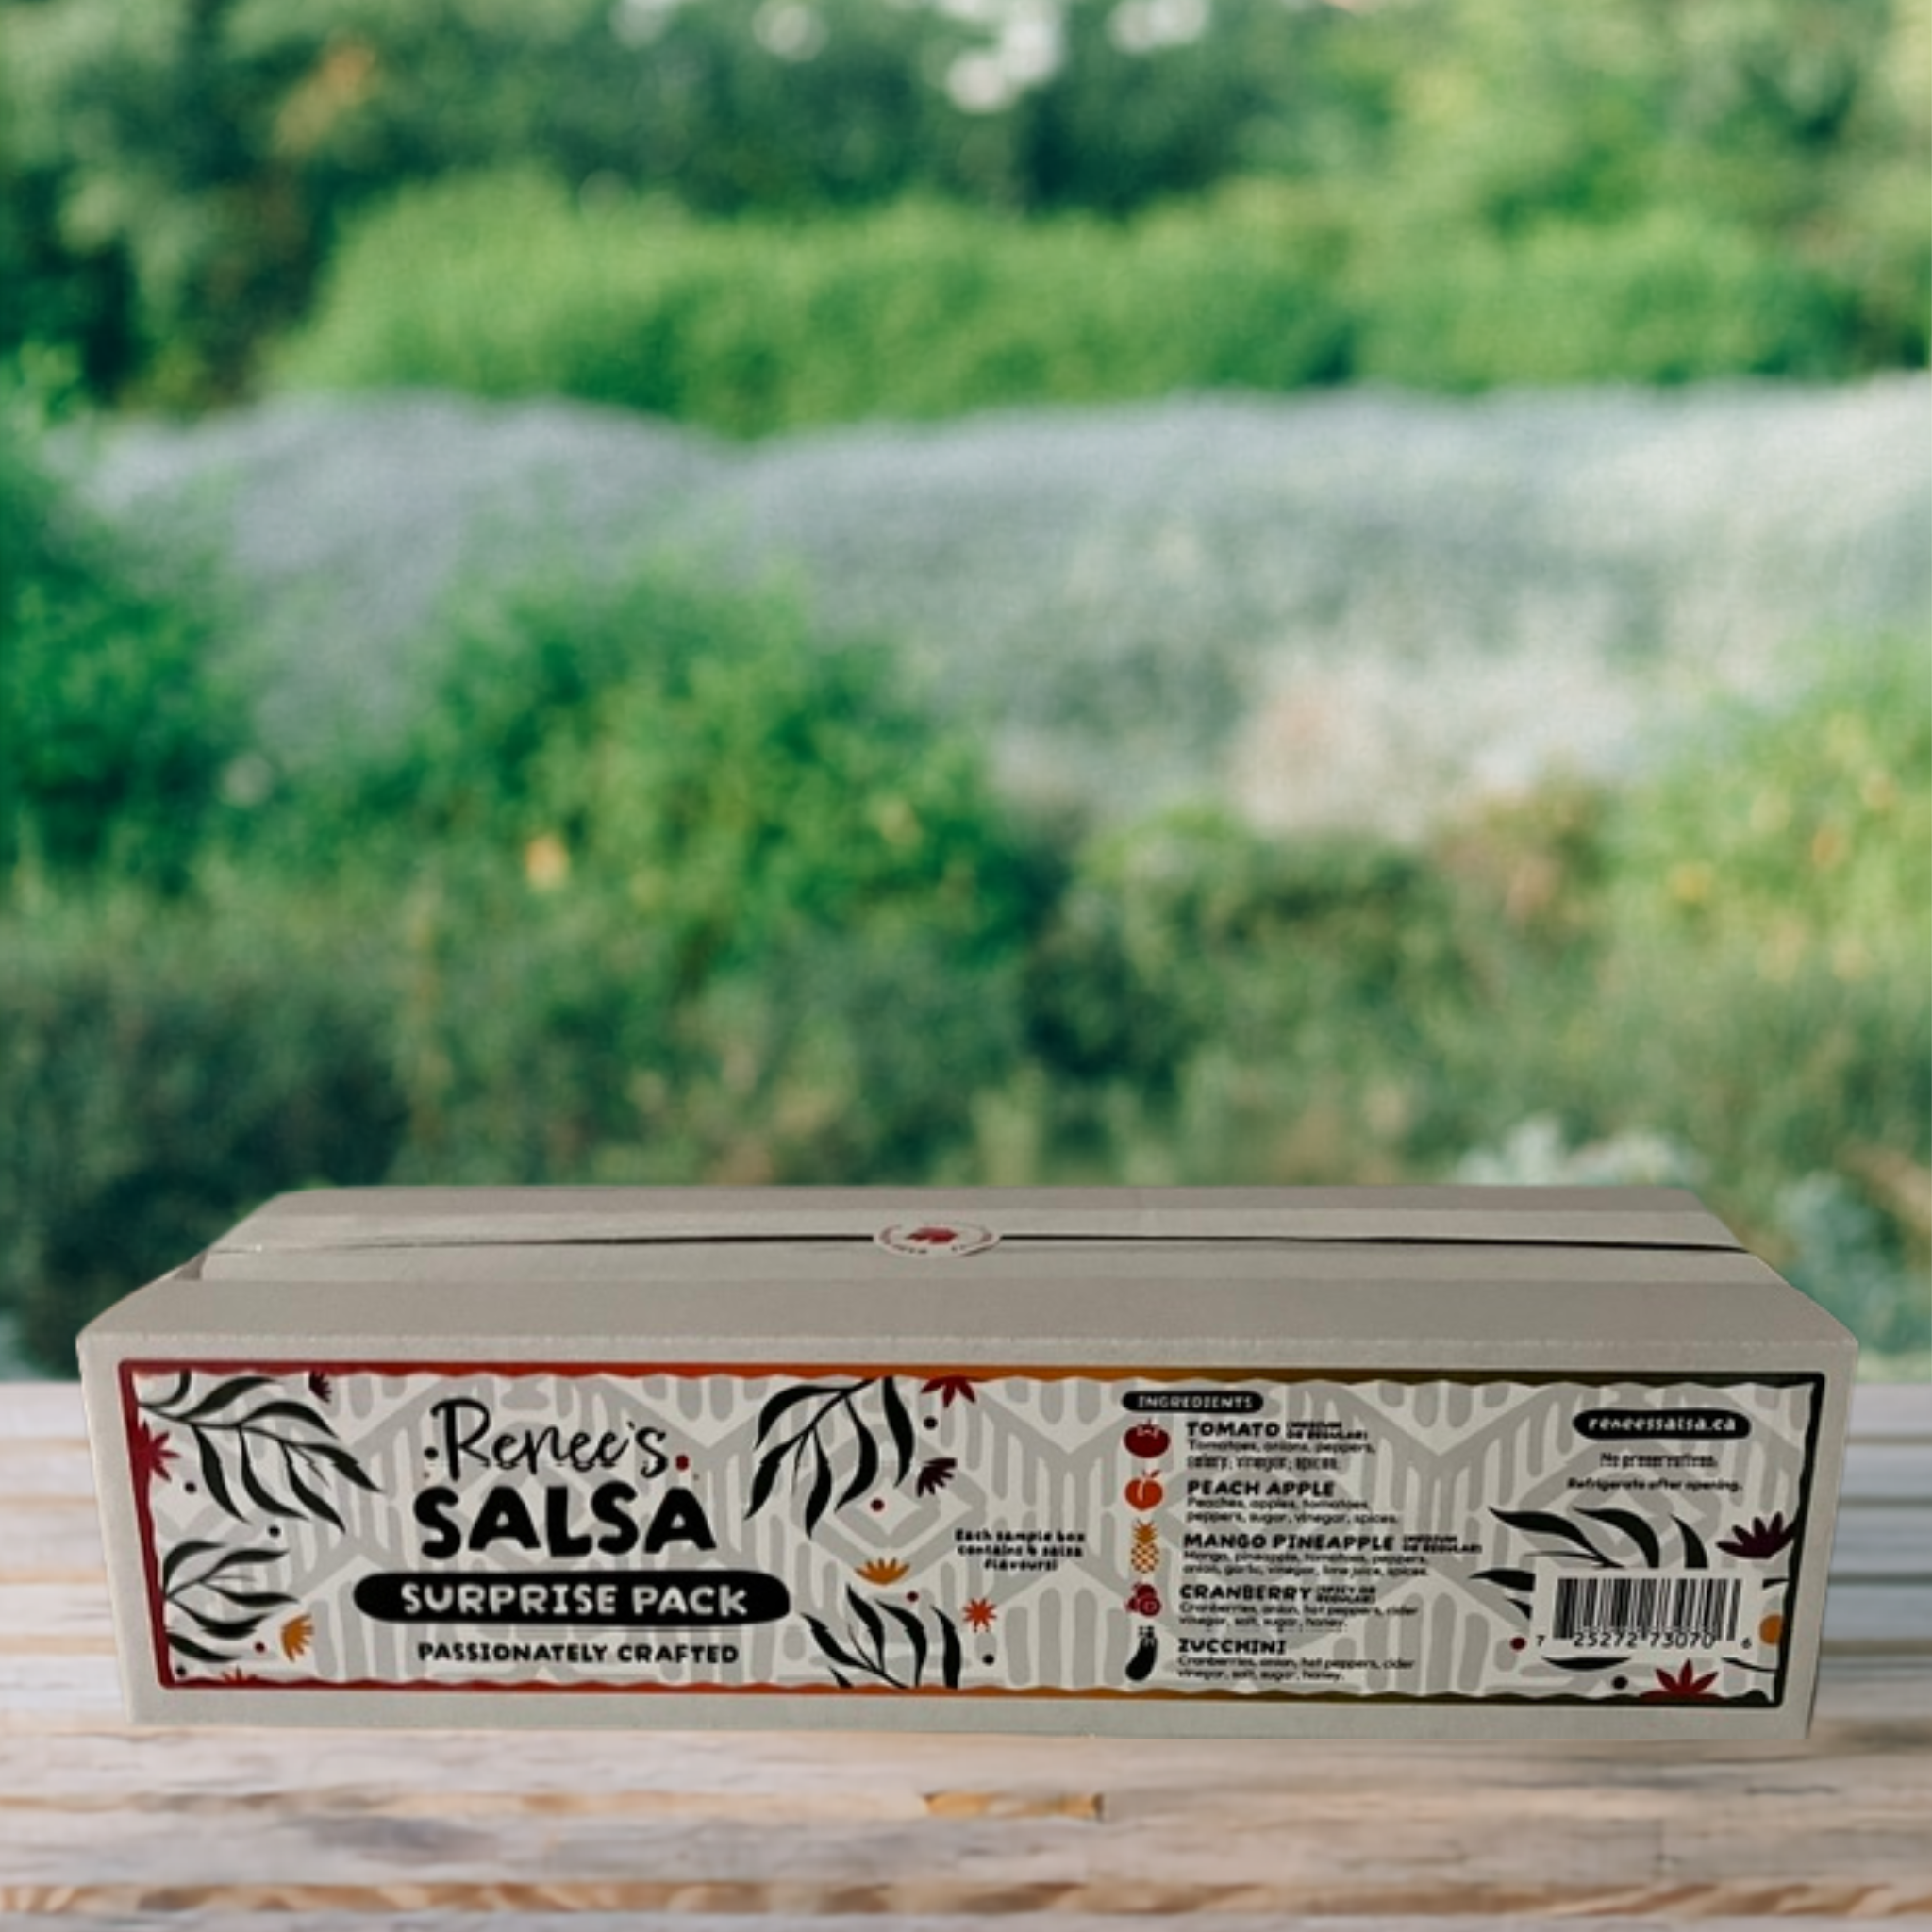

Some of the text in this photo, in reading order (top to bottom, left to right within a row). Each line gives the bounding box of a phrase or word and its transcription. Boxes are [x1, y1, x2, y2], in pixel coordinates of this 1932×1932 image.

[1138, 1395, 1253, 1408] INGREDIENTS
[1187, 1422, 1280, 1437] TOMATO
[1589, 1418, 1736, 1432] reneessalsa.ca
[431, 1398, 668, 1481] Renee's
[1187, 1480, 1335, 1497] PEACH APPLE
[1567, 1478, 1645, 1491] Refrigerate
[1647, 1477, 1682, 1490] after
[413, 1481, 717, 1559] SALSA
[1183, 1533, 1267, 1549] MANGO
[1274, 1534, 1394, 1552] PINEAPPLE
[401, 1583, 748, 1617] SURPRISE PACK
[1179, 1584, 1311, 1600] CRANBERRY
[1178, 1639, 1286, 1654] ZUCCHINI
[1536, 1633, 1752, 1649] 7 25272 73070 6
[418, 1642, 740, 1664] PASSIONATELY CRAFTED
